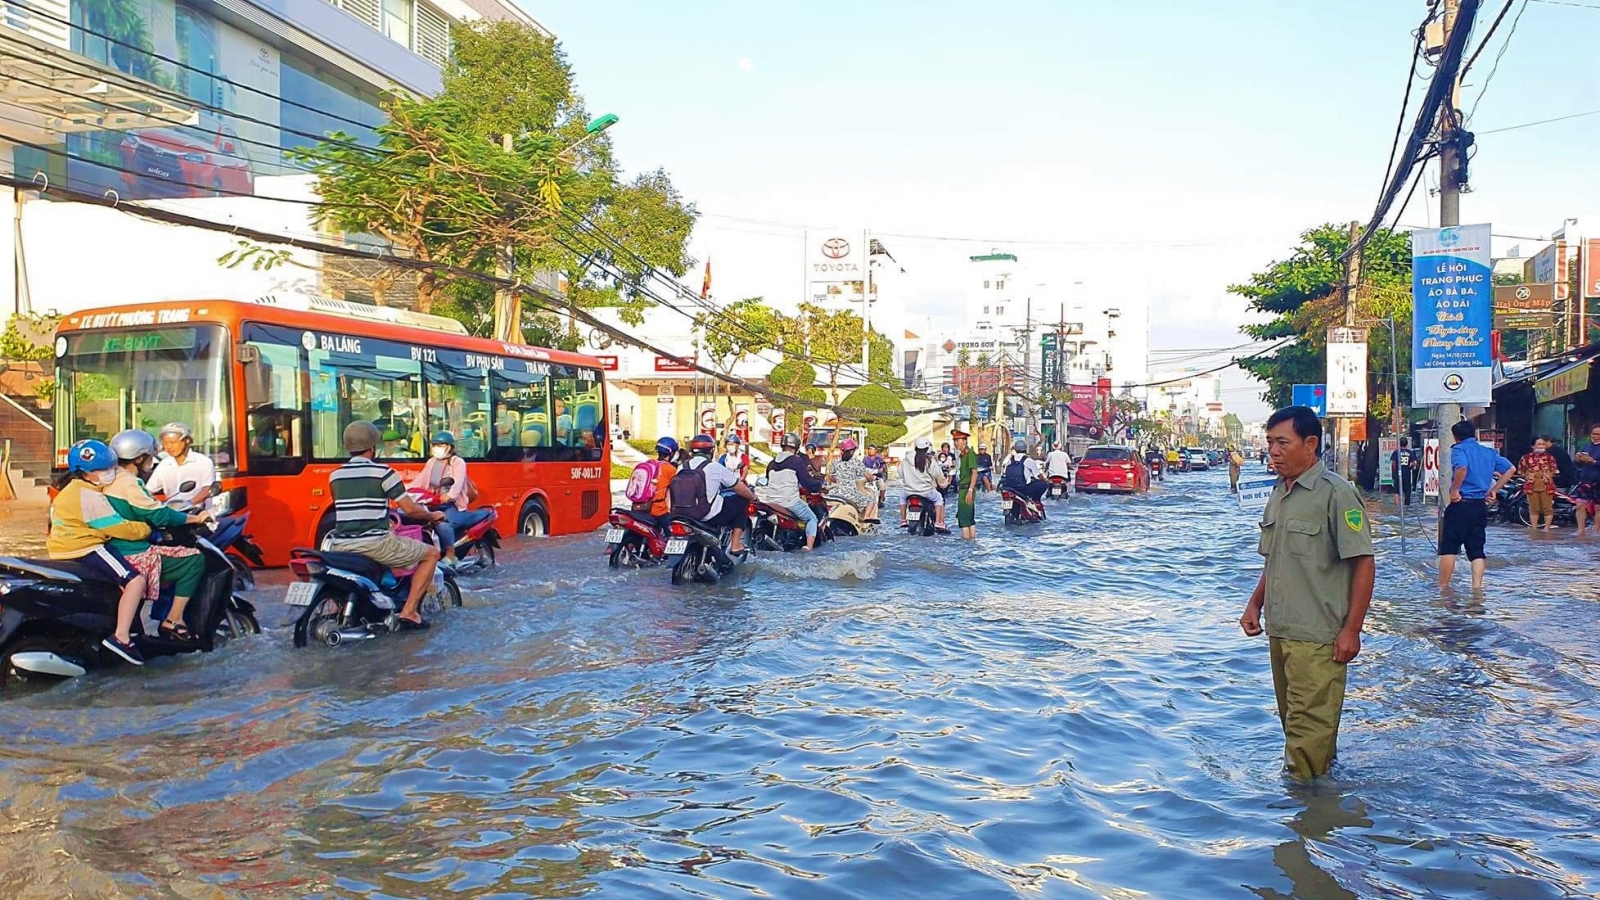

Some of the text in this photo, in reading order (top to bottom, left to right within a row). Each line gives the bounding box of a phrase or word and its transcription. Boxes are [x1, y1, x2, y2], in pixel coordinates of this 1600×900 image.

[814, 264, 858, 272] TOYOTA
[1437, 263, 1466, 274] LỄ HỘI
[1421, 275, 1484, 285] TRANG PHỤC
[1428, 286, 1477, 297] ÁO BÀ BA,
[1436, 299, 1470, 308] ÁO DÀI
[1513, 299, 1530, 308] Ông
[1532, 300, 1550, 308] Mập
[79, 315, 94, 330] XE
[158, 308, 190, 324] TRANG
[103, 338, 120, 353] XE
[320, 335, 335, 351] BA
[336, 335, 362, 354] LÁNG
[410, 346, 422, 360] BV
[422, 348, 437, 363] 121
[466, 354, 476, 368] BV
[570, 466, 602, 480] 50F-001.77
